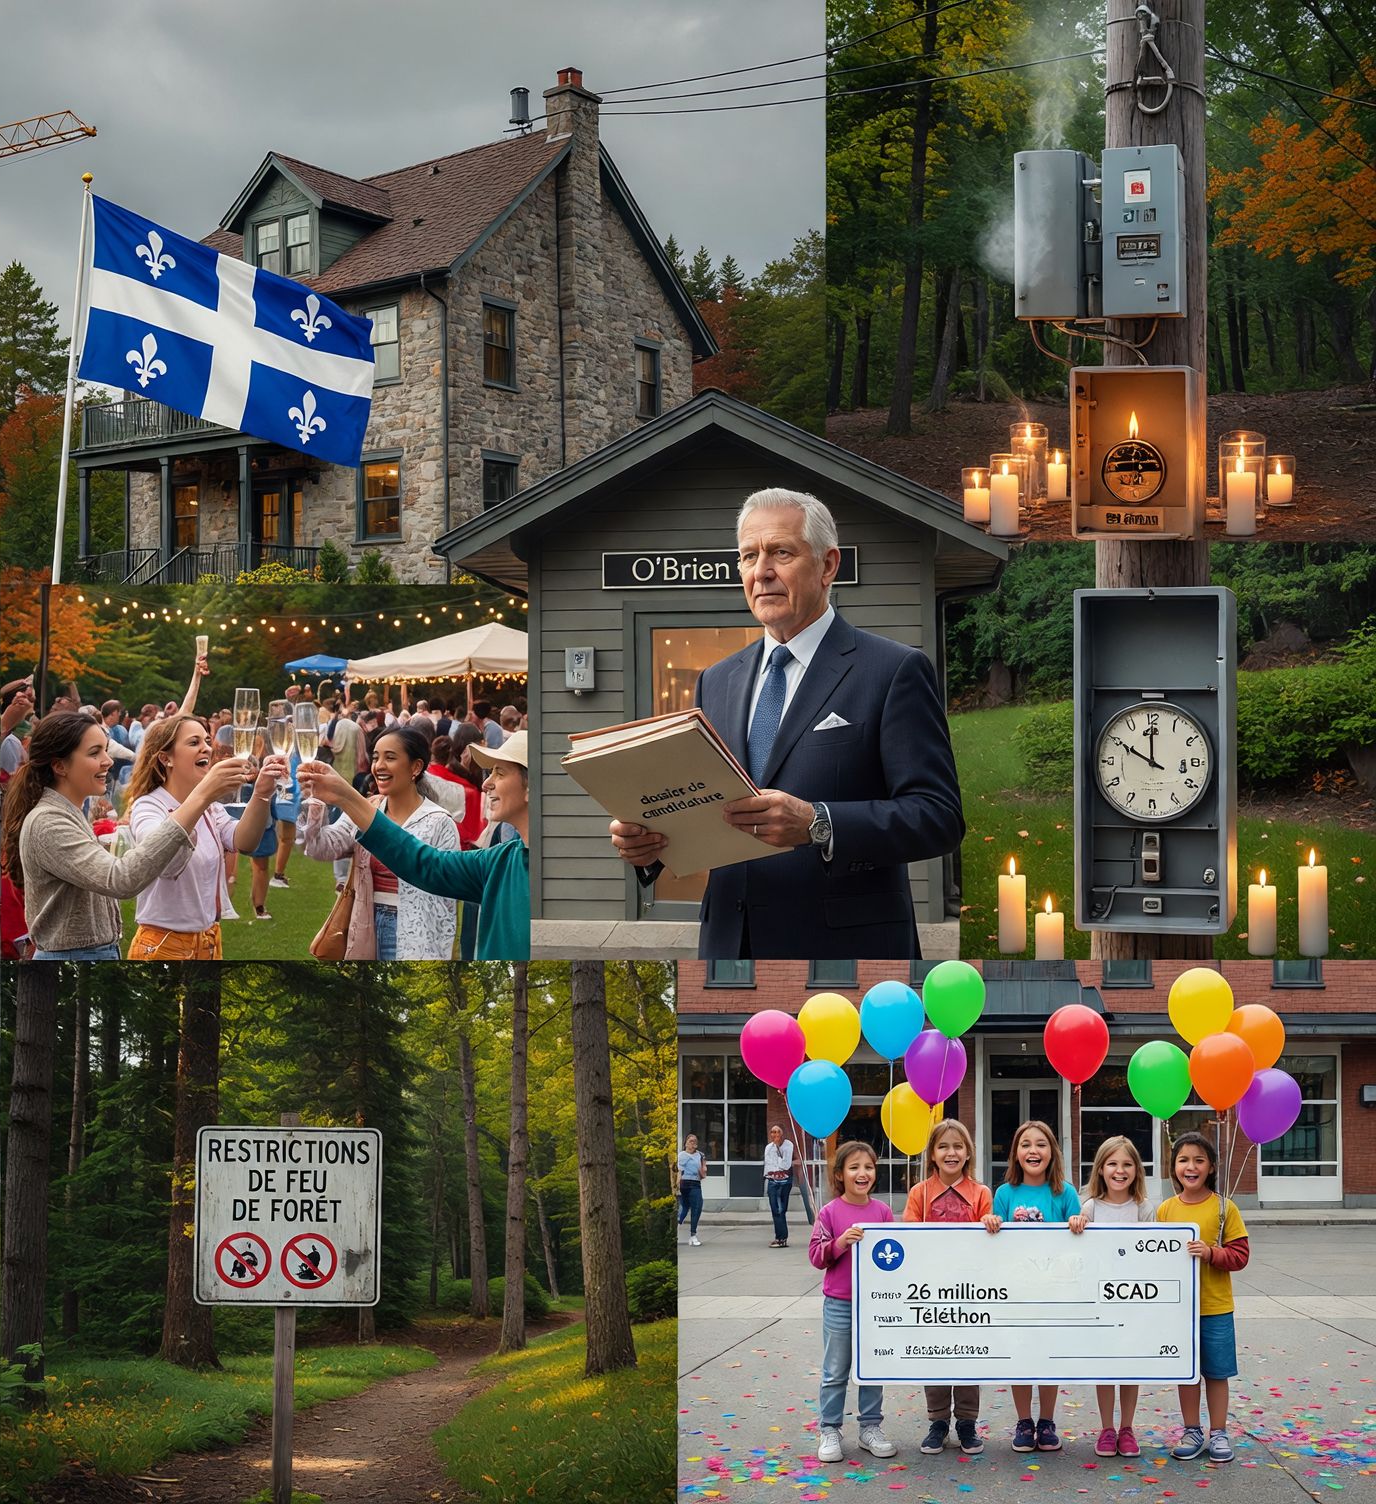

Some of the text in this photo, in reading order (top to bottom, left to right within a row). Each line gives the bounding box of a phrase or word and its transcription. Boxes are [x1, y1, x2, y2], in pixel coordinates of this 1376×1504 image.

[632, 557, 731, 581] O'Brien
[208, 1138, 370, 1165] RESTRICTIONS
[248, 1170, 328, 1194] DE FEU
[232, 1198, 261, 1222] DE
[907, 1283, 931, 1300] 26
[938, 1283, 1009, 1300] millions
[1103, 1282, 1159, 1301] $CAD
[909, 1306, 991, 1324] Téléthon
